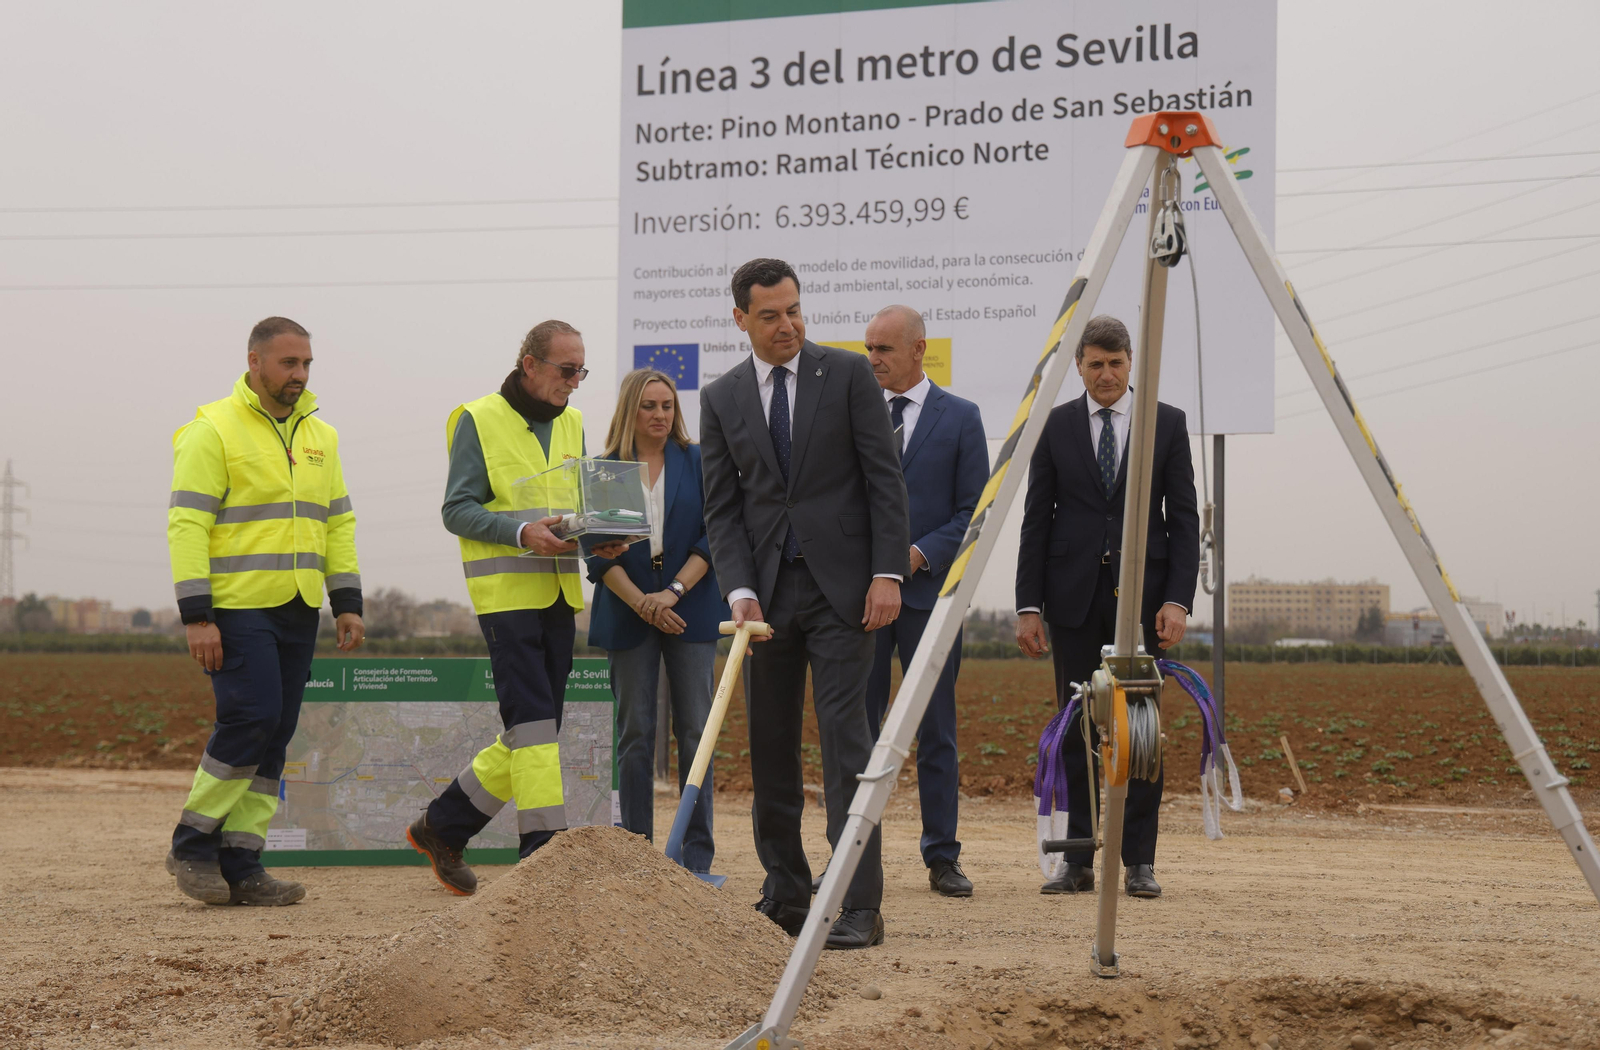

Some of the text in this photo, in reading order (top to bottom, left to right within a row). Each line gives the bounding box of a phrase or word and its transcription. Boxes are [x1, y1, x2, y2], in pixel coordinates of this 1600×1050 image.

[638, 23, 1198, 96] Línea 3 del metro de Sevilla
[637, 122, 712, 144] Norte:
[722, 116, 776, 139] Pino
[786, 112, 900, 135] Montano
[926, 101, 1003, 127] Prado
[1012, 98, 1043, 122] de
[1053, 97, 1103, 119] San
[1113, 81, 1252, 115] Sebastián
[637, 141, 1048, 182] Subtramo: Ramal Técnico Norte
[635, 197, 969, 234] Inversión: 6.393.459,99 €
[633, 264, 713, 279] Contribución
[717, 264, 727, 276] al
[799, 259, 848, 272] modelo
[851, 259, 867, 271] de
[870, 254, 939, 272] movilidad,
[942, 257, 970, 270] para
[975, 254, 985, 266] la
[989, 249, 1073, 265] consecución
[634, 289, 686, 302] mayores
[688, 287, 721, 298] cotas
[834, 277, 903, 295] ambiental,
[906, 276, 943, 290] social
[946, 279, 955, 293] y
[957, 273, 1033, 288] económica.
[633, 319, 687, 333] Proyecto
[690, 315, 736, 329] cofinan
[812, 311, 850, 325] Unión
[936, 307, 980, 320] Estado
[984, 305, 1036, 321] Español
[703, 340, 735, 353] Unión
[353, 668, 389, 678] Consejería
[390, 668, 398, 676] de
[569, 669, 609, 679] de Sevill
[575, 682, 593, 690] Prado
[594, 682, 602, 690] de
